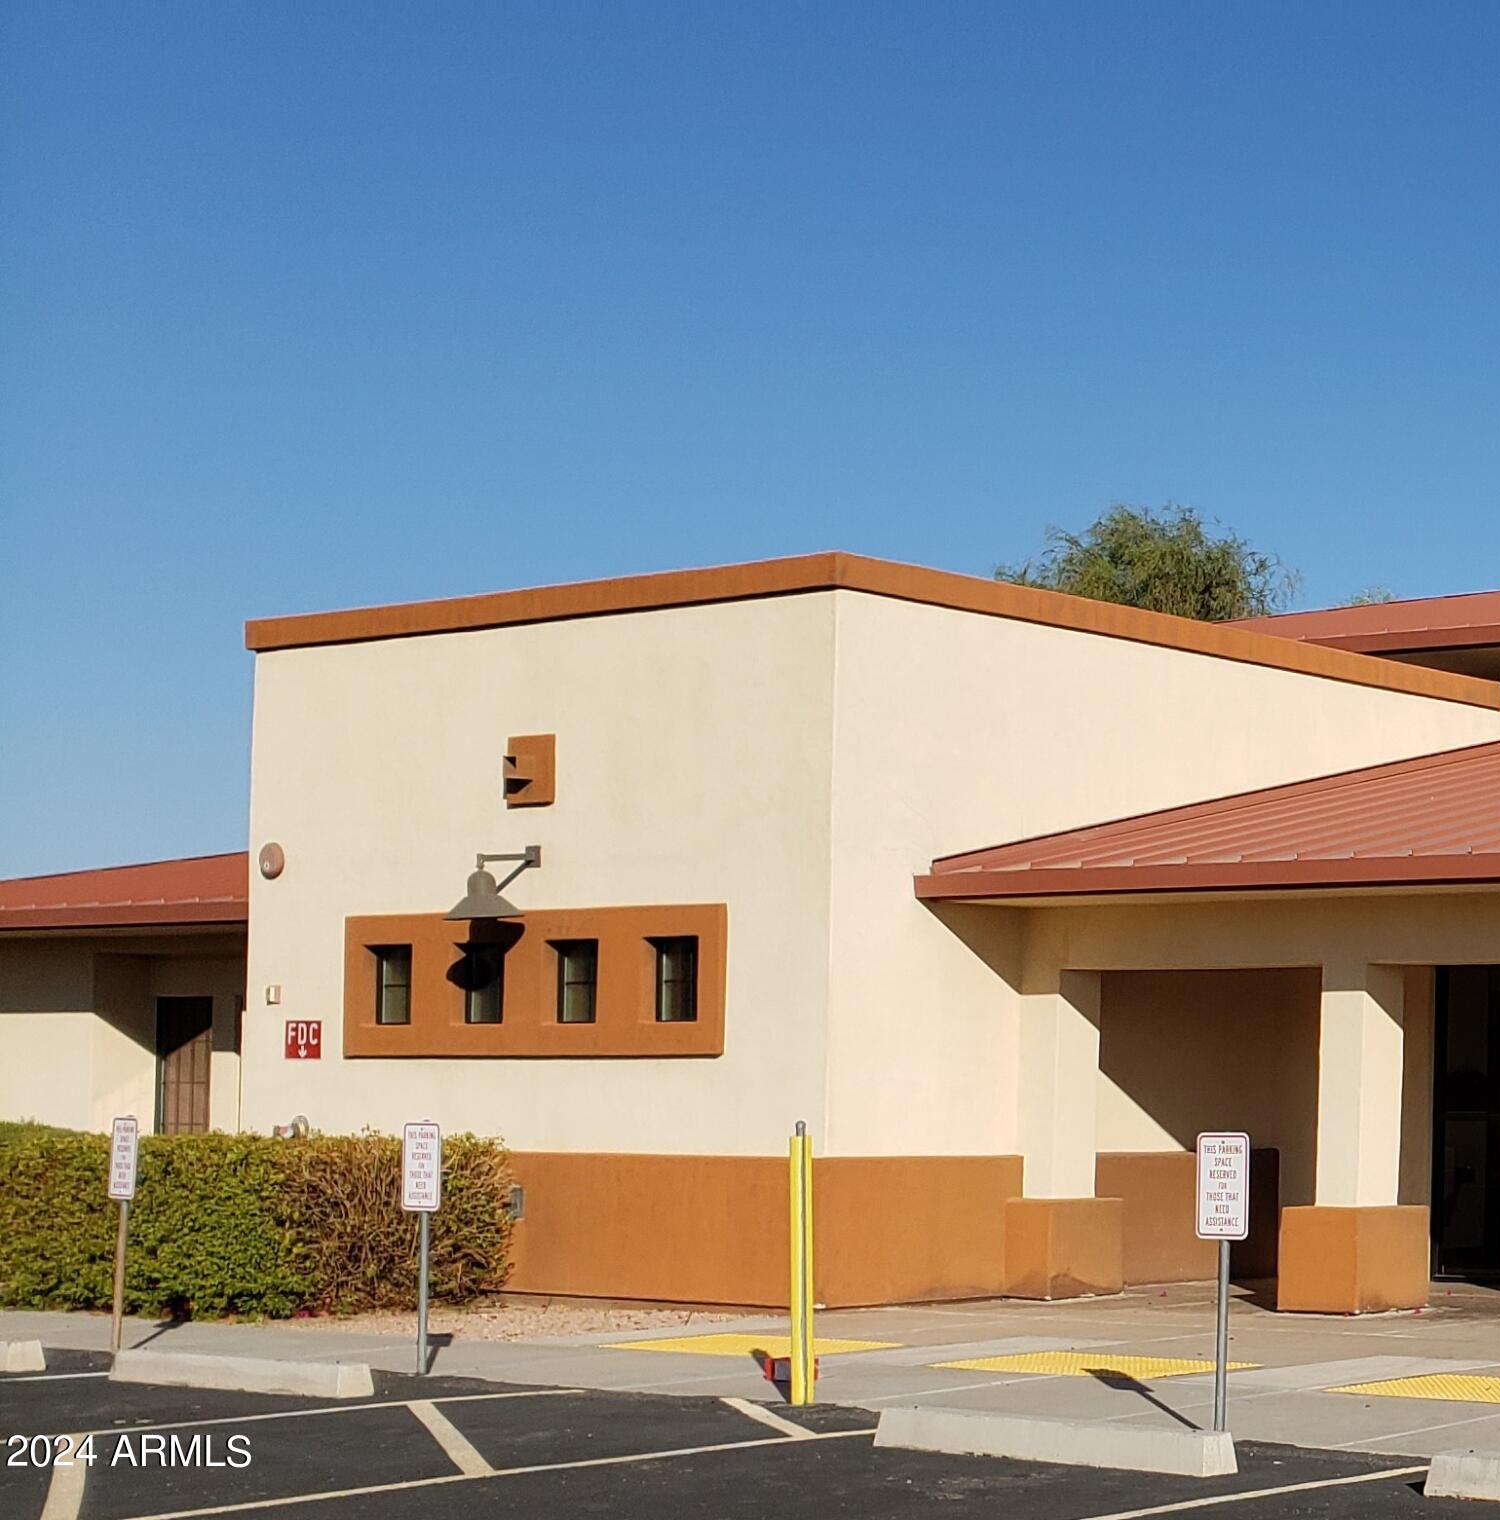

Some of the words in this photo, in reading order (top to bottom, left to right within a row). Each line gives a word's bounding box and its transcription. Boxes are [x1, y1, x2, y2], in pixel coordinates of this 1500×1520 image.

[287, 1022, 318, 1046] FDC
[1204, 1144, 1217, 1154] THIS
[1218, 1144, 1243, 1154] PARKING
[1214, 1157, 1232, 1167] SPACE
[1209, 1169, 1237, 1179] RESERVED
[1206, 1192, 1224, 1201] THOSE
[1225, 1192, 1239, 1201] THAT
[1215, 1204, 1230, 1214] NEED
[1205, 1216, 1239, 1227] ASSISTANCE
